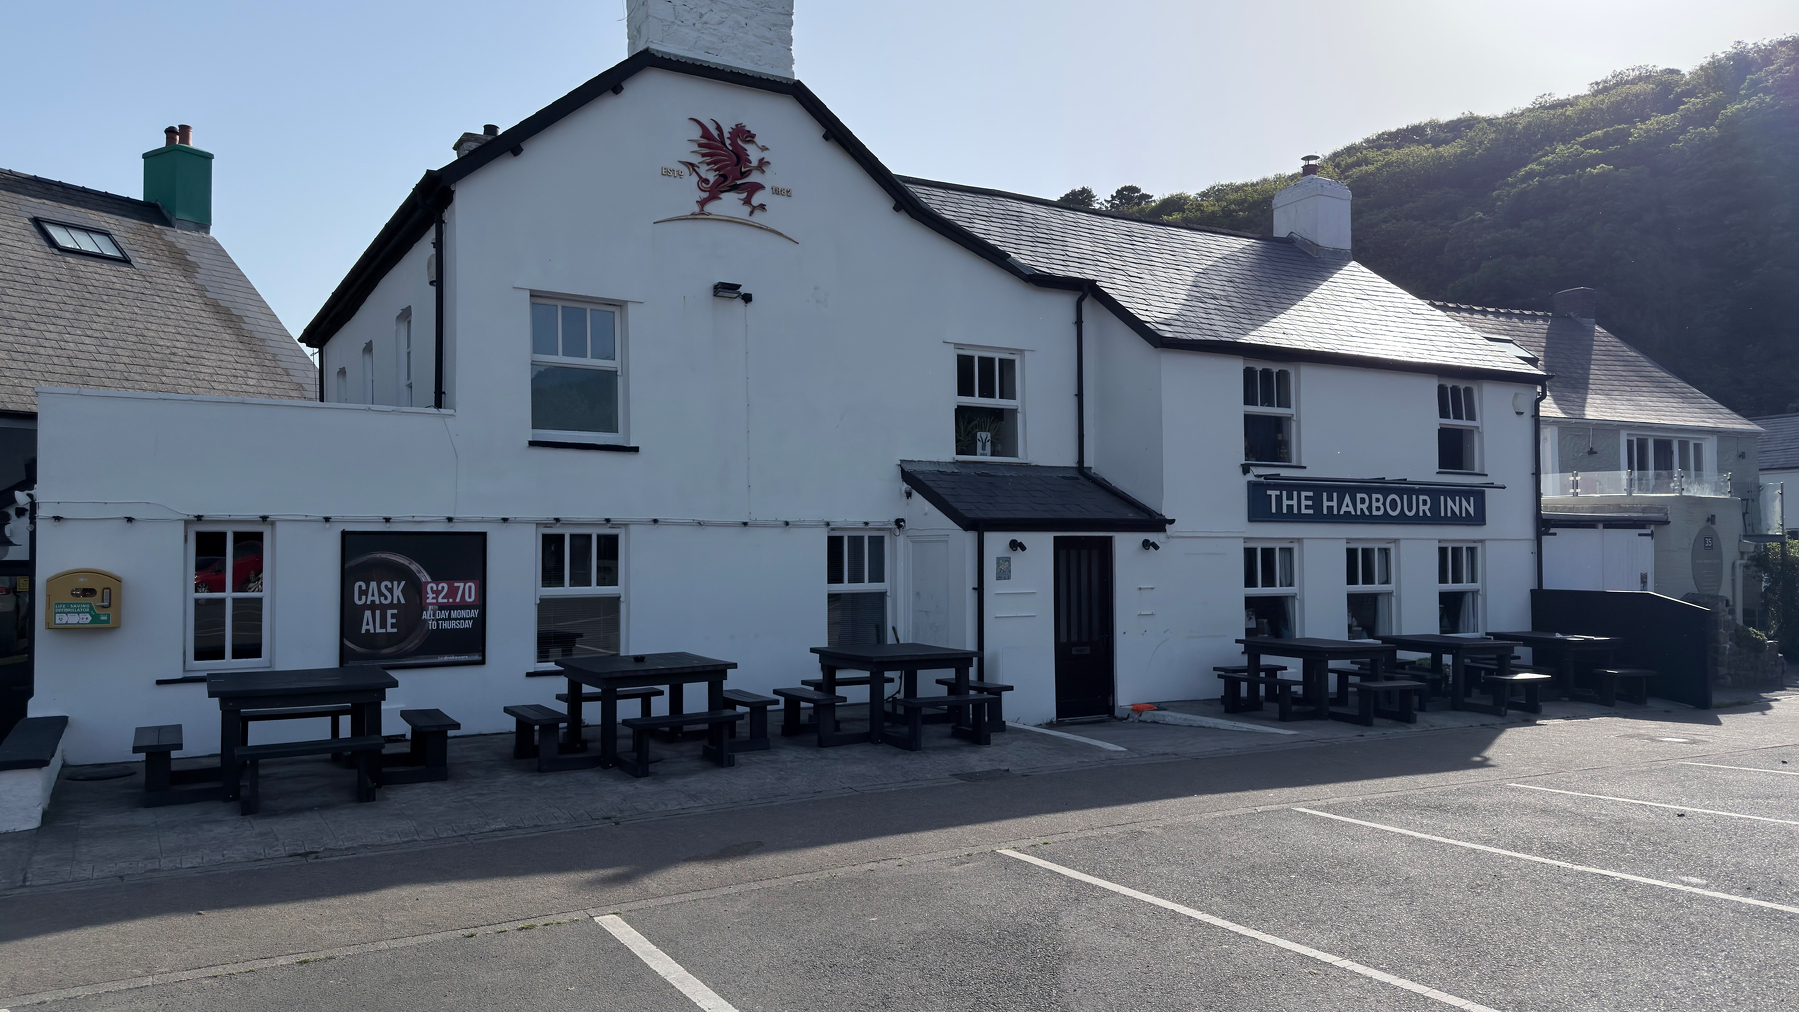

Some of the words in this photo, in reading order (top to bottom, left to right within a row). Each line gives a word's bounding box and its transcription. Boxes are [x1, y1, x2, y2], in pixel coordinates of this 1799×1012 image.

[771, 186, 792, 198] 1882
[1267, 490, 1314, 515] THE
[1322, 492, 1432, 517] HARBOUR
[1440, 495, 1474, 518] INN
[1705, 538, 1712, 547] 35
[354, 581, 406, 605] CASK
[426, 582, 475, 603] £2.70
[361, 610, 398, 633] ALE
[422, 611, 435, 620] ALL
[436, 610, 450, 620] DAY
[451, 609, 479, 618] MONDAY
[428, 621, 437, 630] TO
[438, 620, 473, 629] THURSDAY
